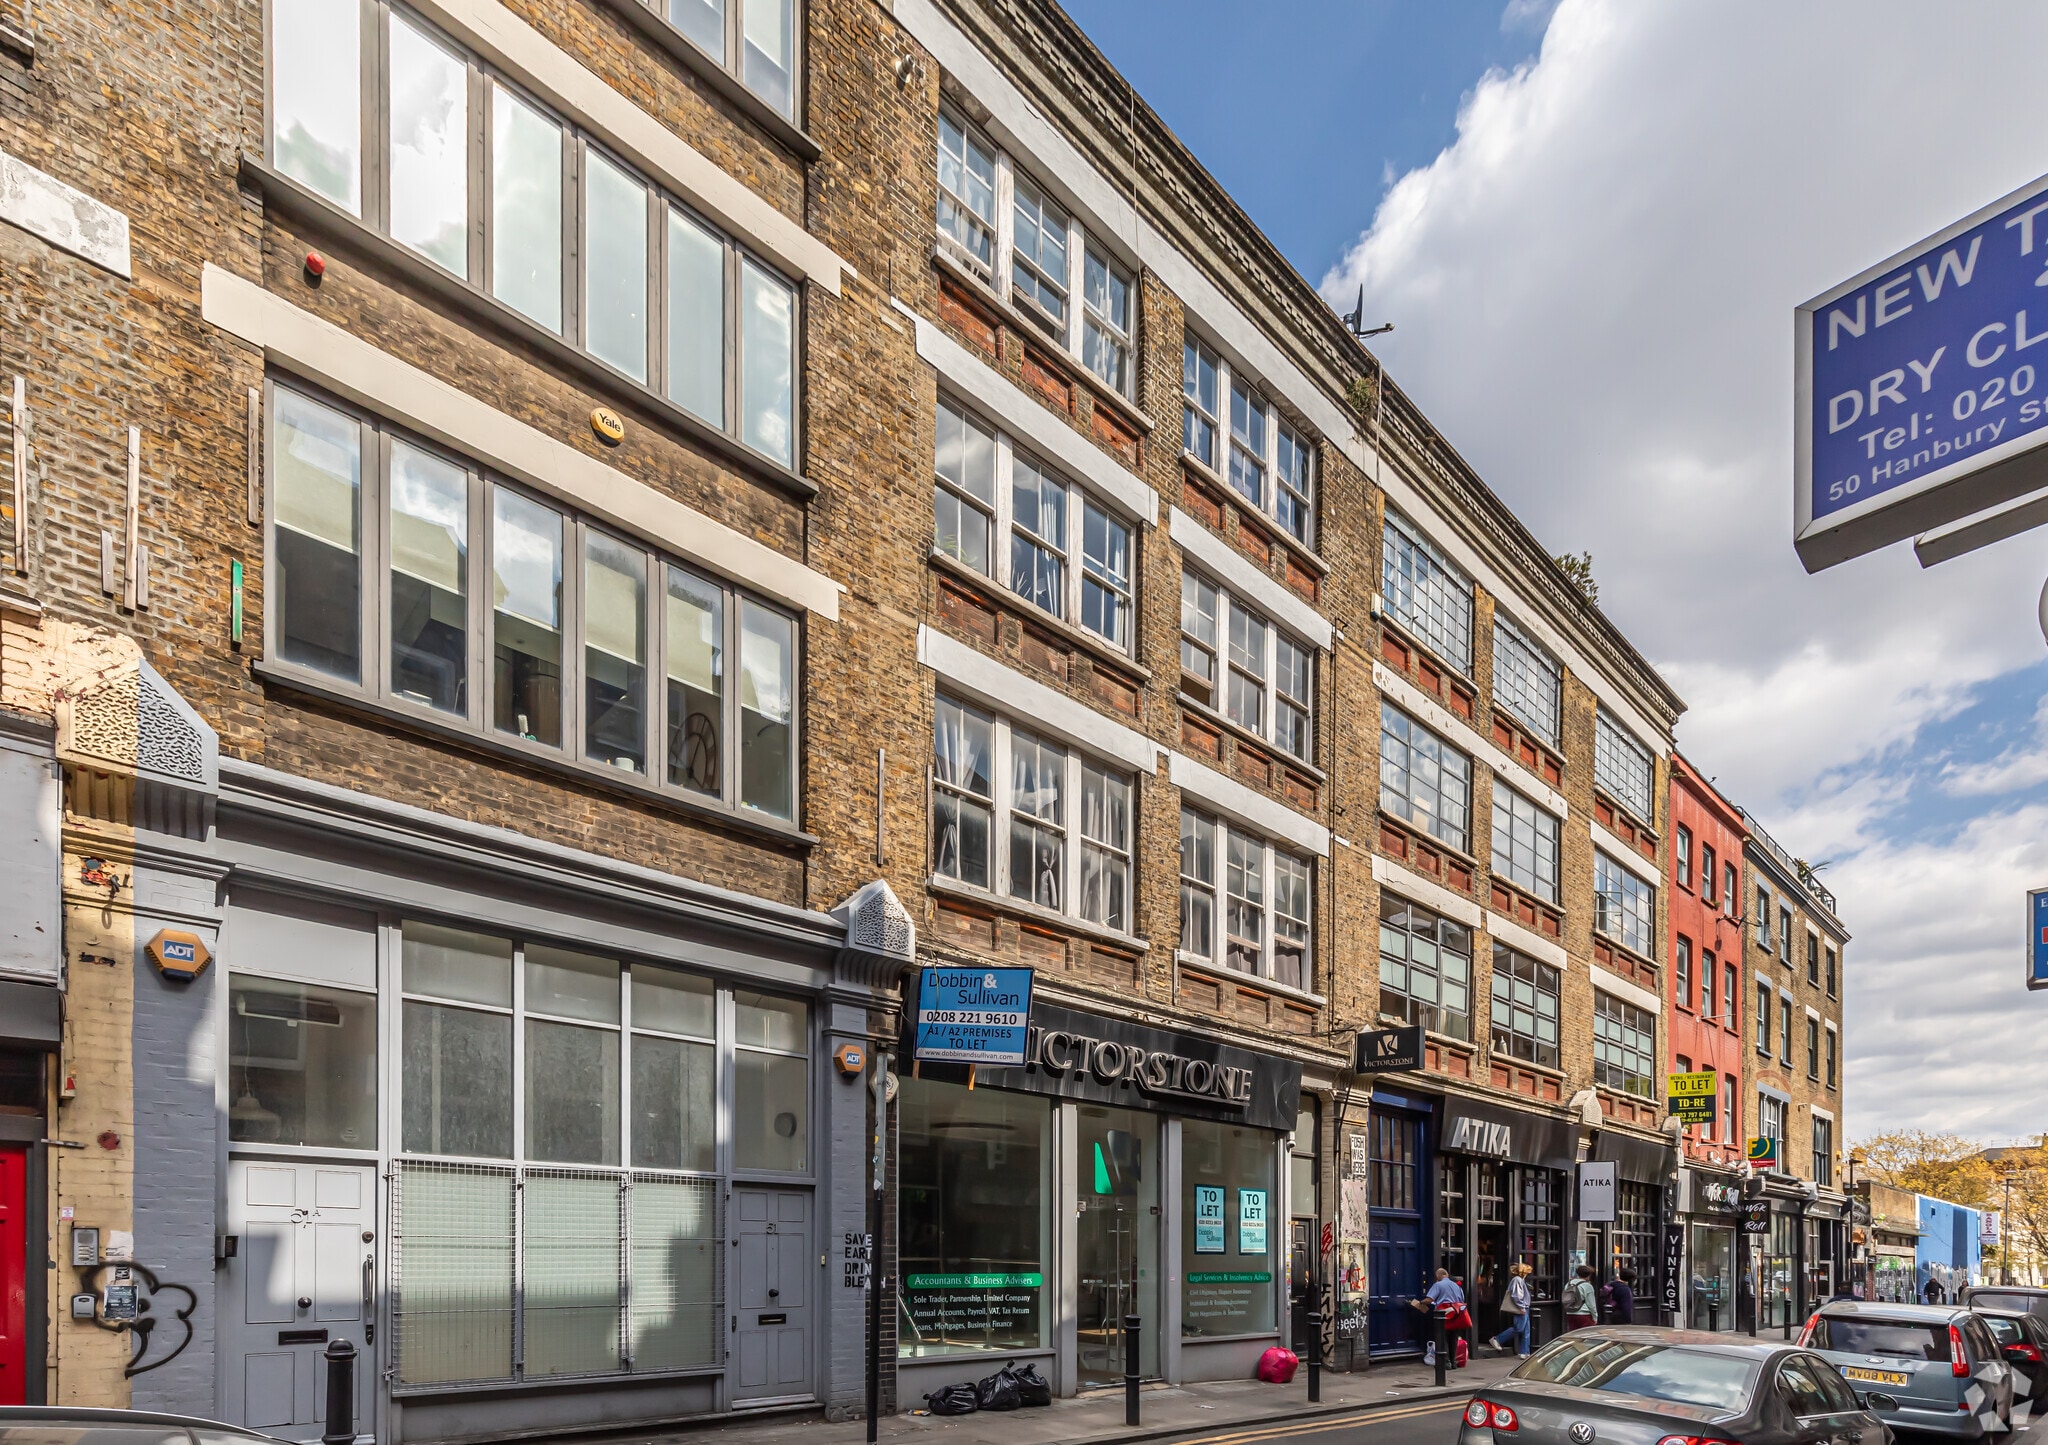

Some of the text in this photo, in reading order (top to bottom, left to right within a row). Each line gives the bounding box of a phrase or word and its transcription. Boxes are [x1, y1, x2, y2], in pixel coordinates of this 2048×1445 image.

[1828, 201, 2048, 351] NEW T
[1828, 346, 1947, 434] DRY
[1858, 364, 2036, 460] Tel: 020
[599, 412, 621, 432] Yale
[1829, 474, 1861, 501] 50
[1872, 417, 2007, 485] Hanbury
[164, 945, 194, 958] ADT
[958, 990, 1019, 1006] Sullivan
[926, 1011, 1017, 1025] 0208 221 9610
[928, 1026, 1012, 1038] A1 / A2 PREMISES
[950, 1038, 987, 1050] TO LET
[846, 1055, 860, 1064] ADT
[925, 1050, 1014, 1060] www.dobbinandsullivan.com
[1026, 1026, 1253, 1101] ICTORSTONE
[1364, 1056, 1414, 1068] VICTORSTONE
[1674, 1080, 1710, 1090] TO LET
[1678, 1098, 1706, 1107] TD-RE
[1451, 1116, 1510, 1157] ATIKA
[1584, 1179, 1611, 1187] ATIKA
[1202, 1190, 1217, 1202] TO
[1246, 1194, 1260, 1206] TO
[1202, 1205, 1220, 1217] LET
[1244, 1208, 1262, 1219] LET
[1744, 1221, 1766, 1230] Roll
[845, 1233, 872, 1246] SAVE
[845, 1247, 872, 1260] EART
[844, 1262, 872, 1276] DRIN
[1666, 1236, 1679, 1308] VINTAGE
[844, 1276, 886, 1290] BLEAH
[914, 1276, 1032, 1286] Accountants & Business Advisers
[1190, 1274, 1202, 1282] Legal
[914, 1296, 928, 1304] Sole
[928, 1295, 948, 1303] Trader,
[950, 1294, 982, 1303] Partnership,
[1004, 1294, 1030, 1303] Company
[914, 1310, 936, 1318] Annual
[938, 1309, 966, 1317] Accounts,
[968, 1308, 988, 1316] Payroll,
[988, 1307, 1001, 1316] VAT,
[915, 1323, 932, 1332] oans,
